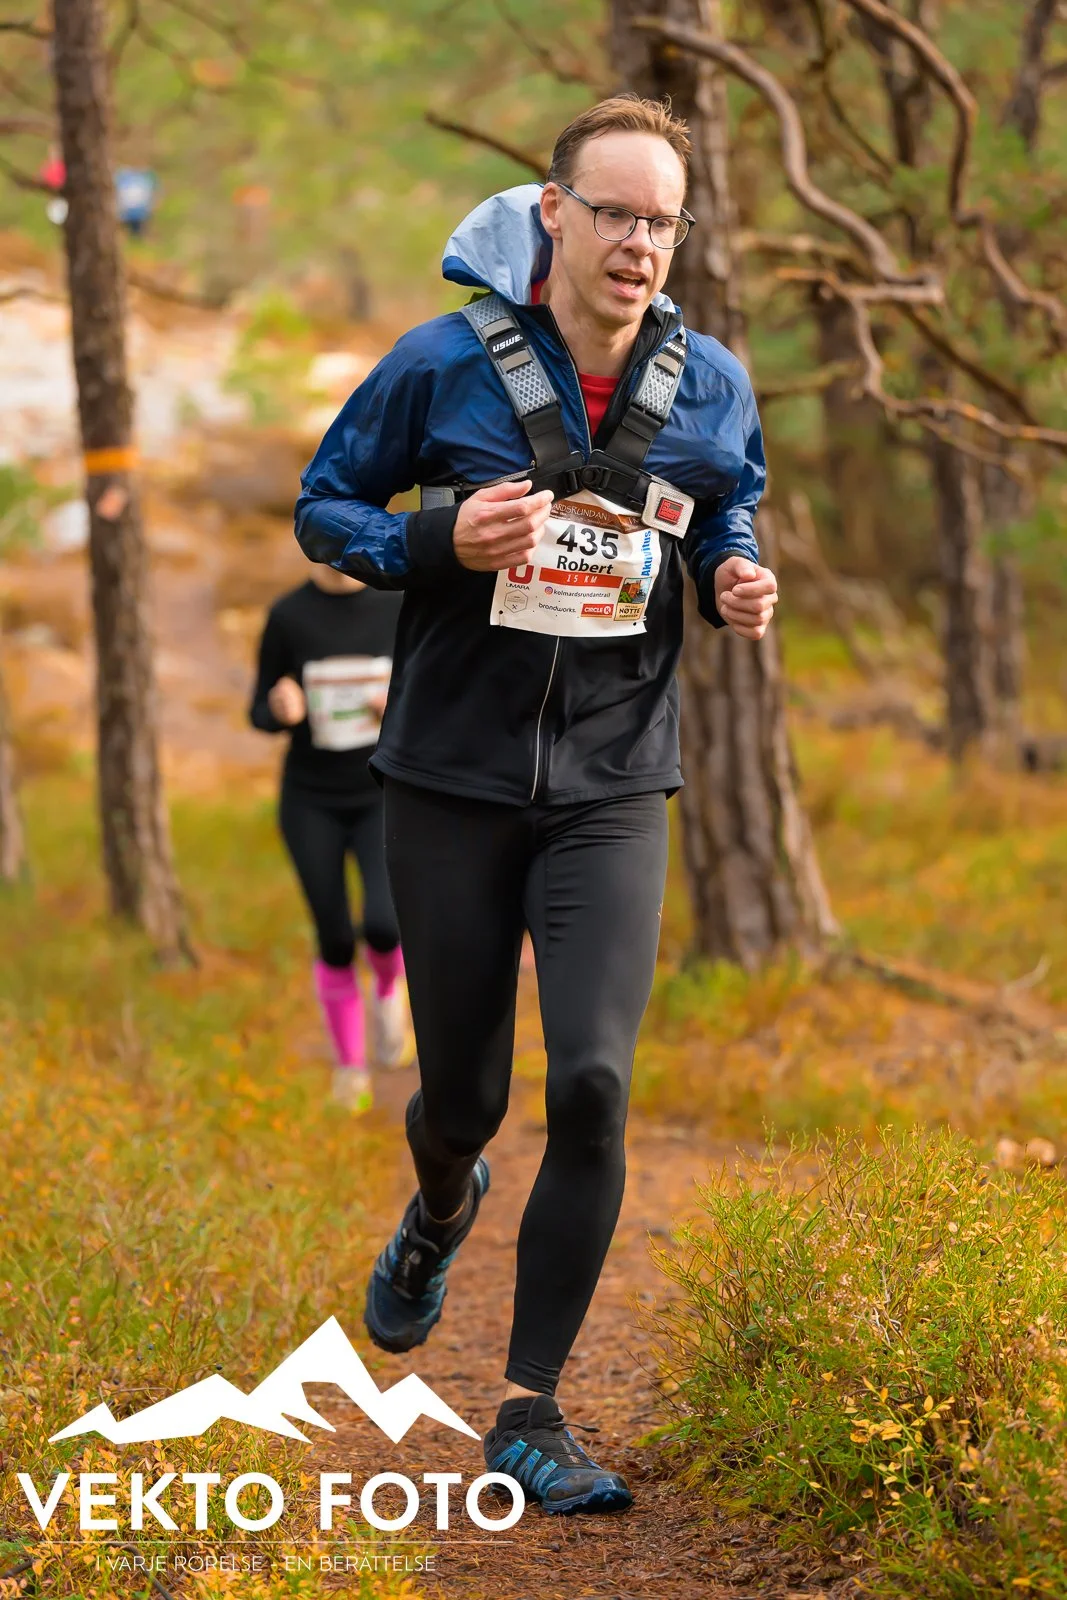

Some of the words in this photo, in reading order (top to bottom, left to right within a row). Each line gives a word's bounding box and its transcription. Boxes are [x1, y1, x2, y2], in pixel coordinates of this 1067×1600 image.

[556, 524, 619, 559] 435
[641, 530, 652, 577] Aktivitus
[557, 555, 613, 574] Robert
[505, 582, 530, 591] UMARA
[567, 575, 578, 583] 15
[584, 576, 597, 584] KM
